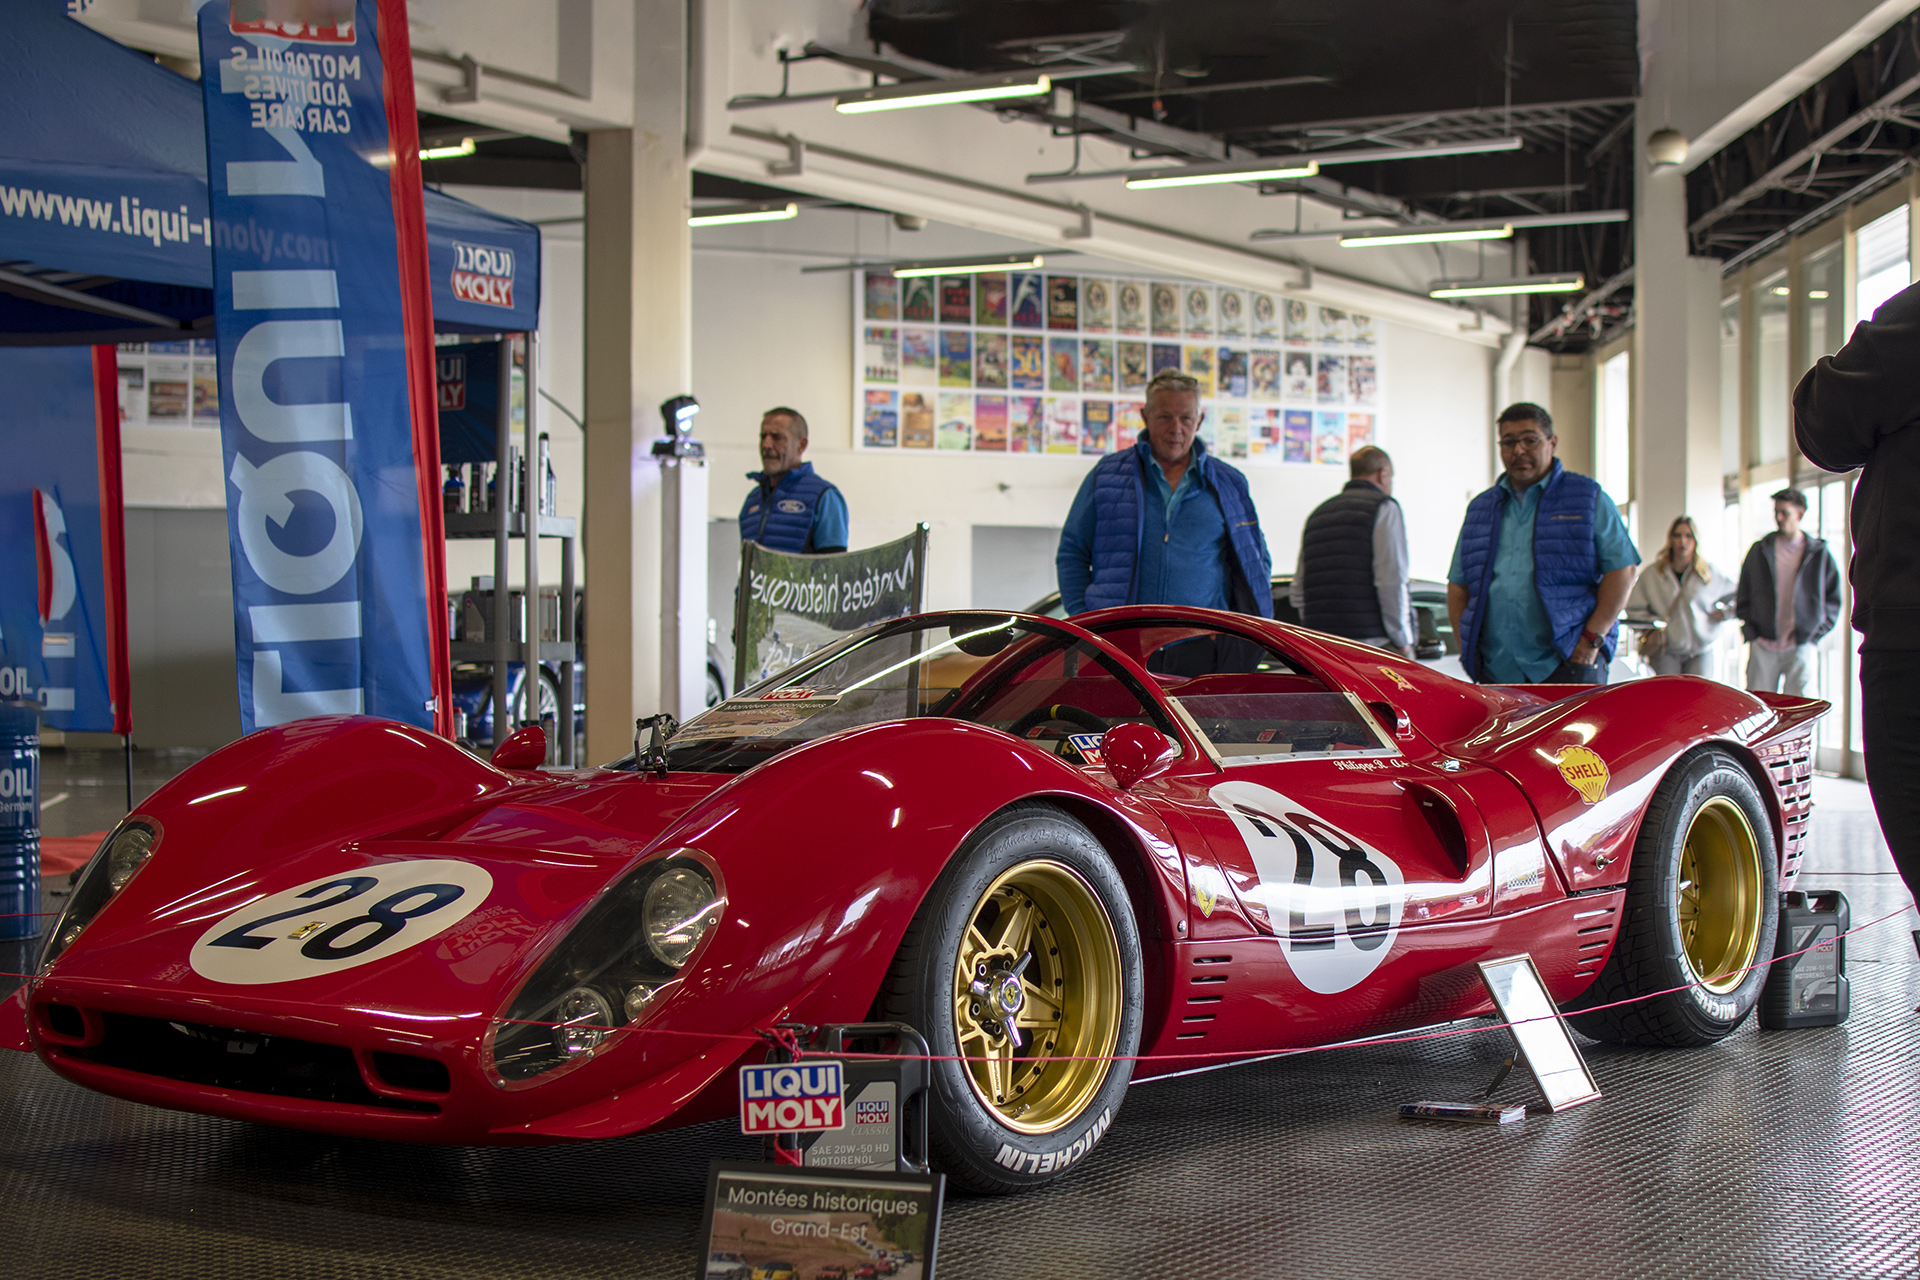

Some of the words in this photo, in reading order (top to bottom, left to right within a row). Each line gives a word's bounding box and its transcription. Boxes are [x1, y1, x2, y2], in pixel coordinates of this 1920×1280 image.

[457, 246, 511, 277] LIQUI
[454, 273, 511, 304] MOLY
[0, 768, 33, 798] OIL
[1565, 763, 1603, 780] SHELL
[1233, 804, 1391, 952] 28
[207, 876, 465, 960] 28
[747, 1066, 837, 1098] LIQUI
[748, 1098, 840, 1130] MOLY
[857, 1102, 888, 1113] LIQUI
[857, 1112, 889, 1123] MOLY
[812, 1146, 832, 1155] SAE
[834, 1144, 872, 1155] 20W-50
[875, 1144, 889, 1153] HD
[994, 1106, 1111, 1174] MICHELIN
[811, 1151, 875, 1167] MOTORENÖL
[728, 1187, 808, 1209] Montées
[813, 1191, 918, 1218] historiques
[770, 1218, 868, 1240] Grand-Est
